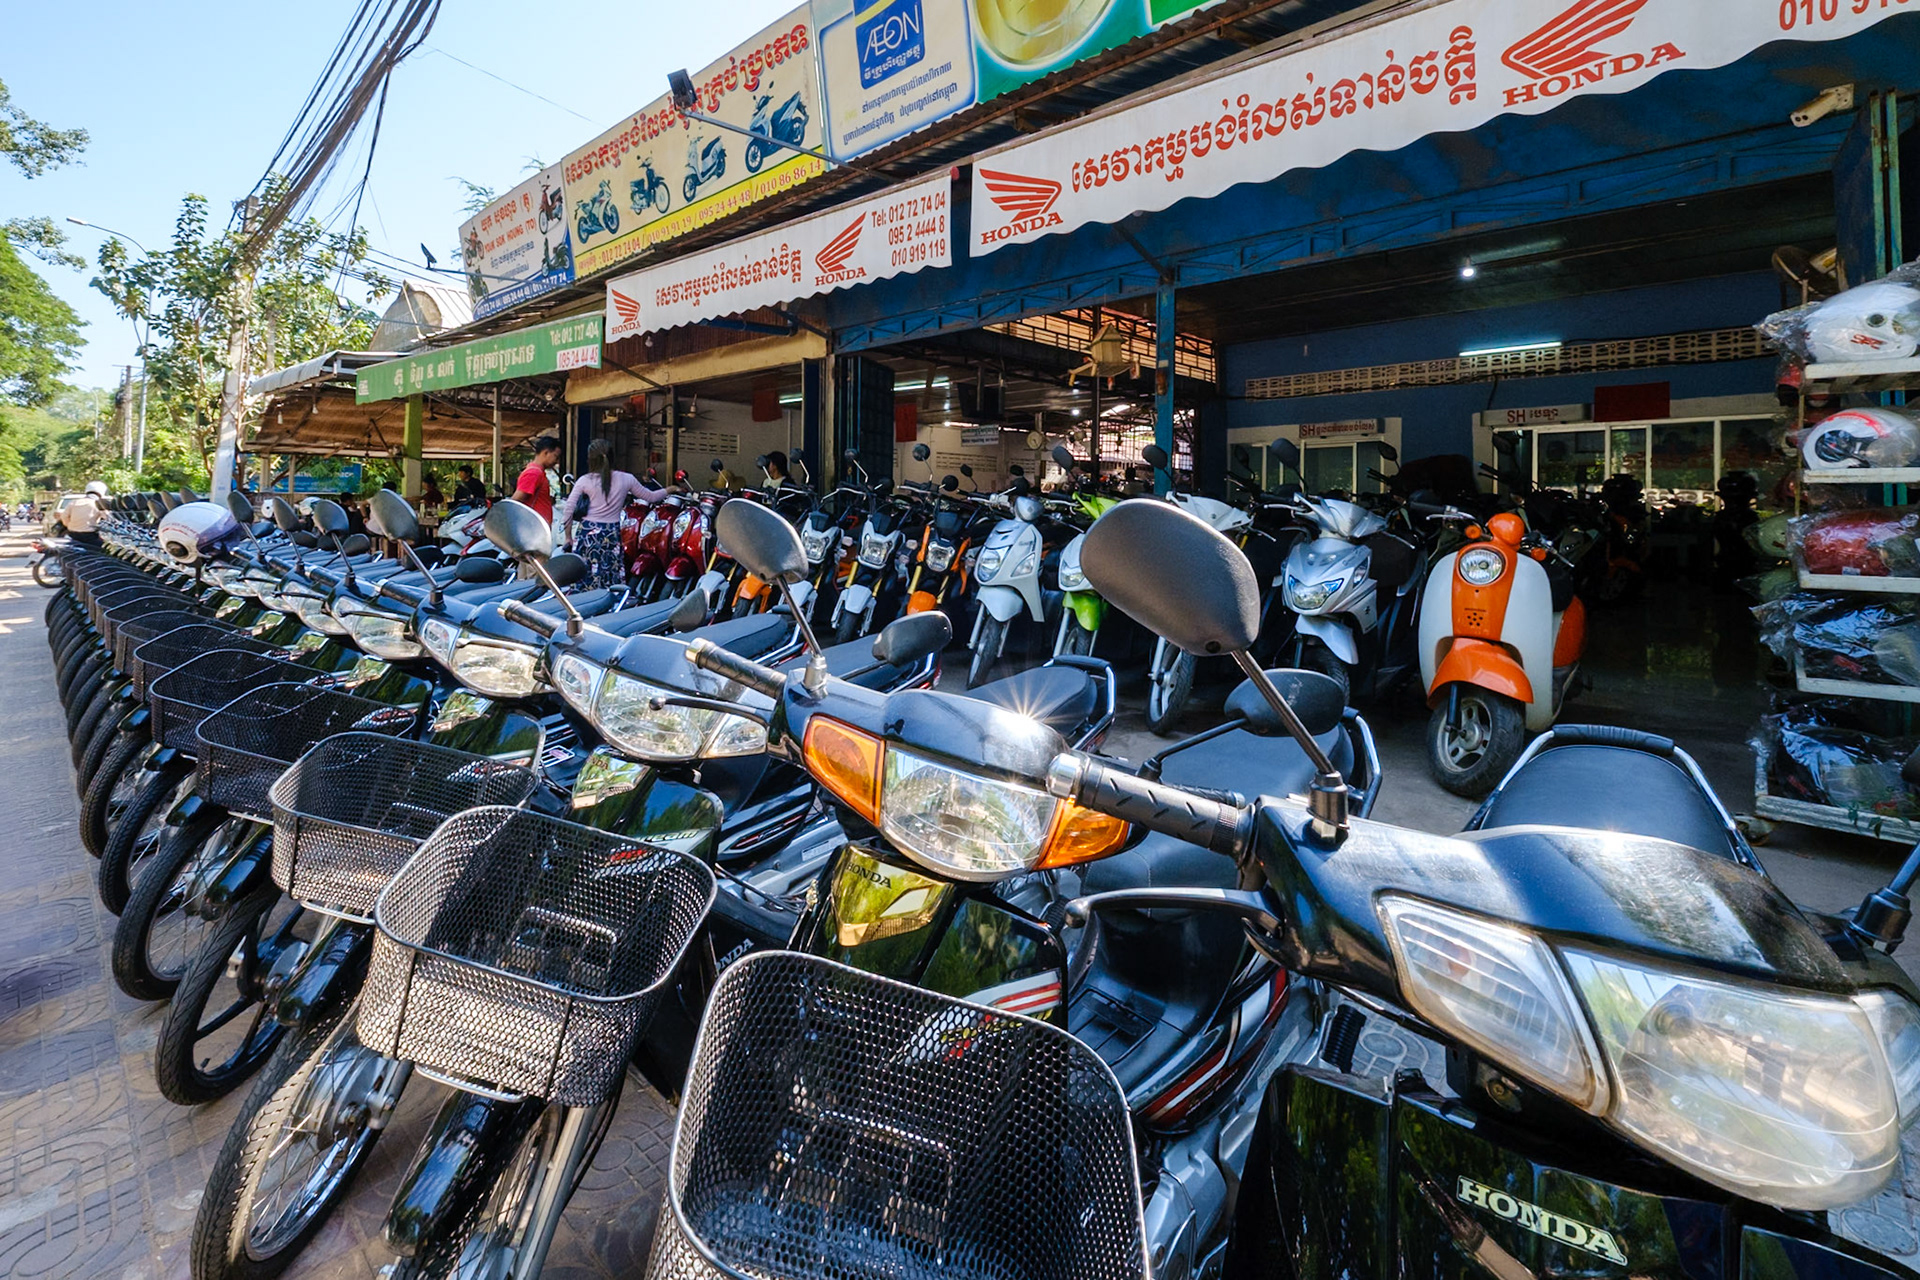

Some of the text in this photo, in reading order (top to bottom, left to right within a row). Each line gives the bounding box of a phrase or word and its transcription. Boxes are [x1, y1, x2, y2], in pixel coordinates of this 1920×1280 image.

[1779, 0, 1838, 31] 010
[1502, 42, 1686, 107] HONDA
[699, 206, 715, 221] 095
[716, 202, 726, 214] 24
[727, 197, 738, 210] 44
[760, 177, 778, 195] 010
[779, 171, 792, 187] 86
[793, 164, 807, 180] 86
[809, 156, 822, 173] 14
[872, 190, 945, 228] Tel: 012 72 74 04
[889, 215, 944, 245] 095 2 4444 8
[980, 212, 1063, 245] HONDA
[891, 238, 945, 267] 010 919 119
[815, 266, 867, 286] HONDA
[611, 319, 641, 335] HONDA
[1301, 424, 1316, 437] SH
[1507, 409, 1526, 423] SH
[846, 862, 892, 889] HONDA
[1458, 1178, 1627, 1264] HONDA
